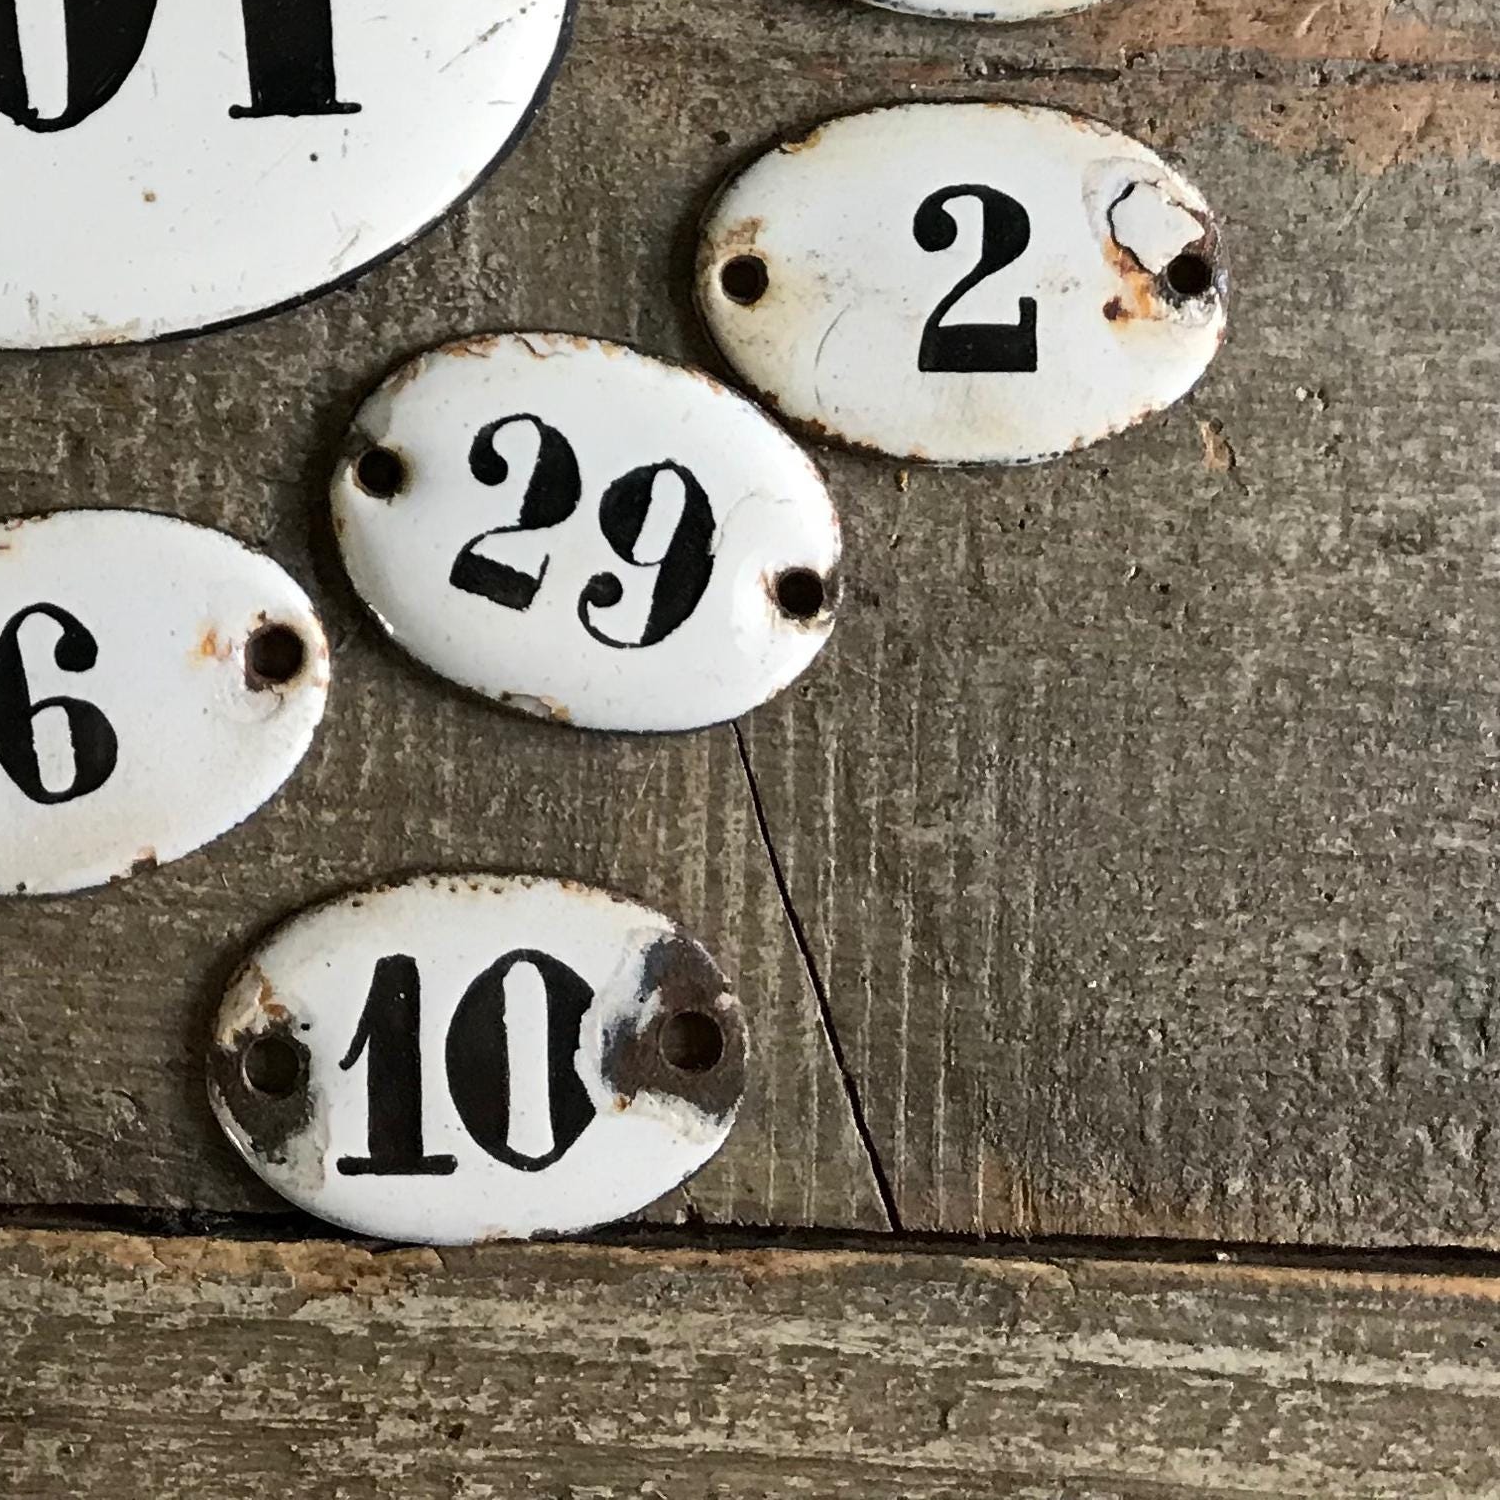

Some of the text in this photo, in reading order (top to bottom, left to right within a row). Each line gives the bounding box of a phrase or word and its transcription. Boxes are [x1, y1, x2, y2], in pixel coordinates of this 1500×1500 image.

[911, 182, 1039, 375] 2
[447, 411, 718, 651] 29
[335, 947, 598, 1178] 10
